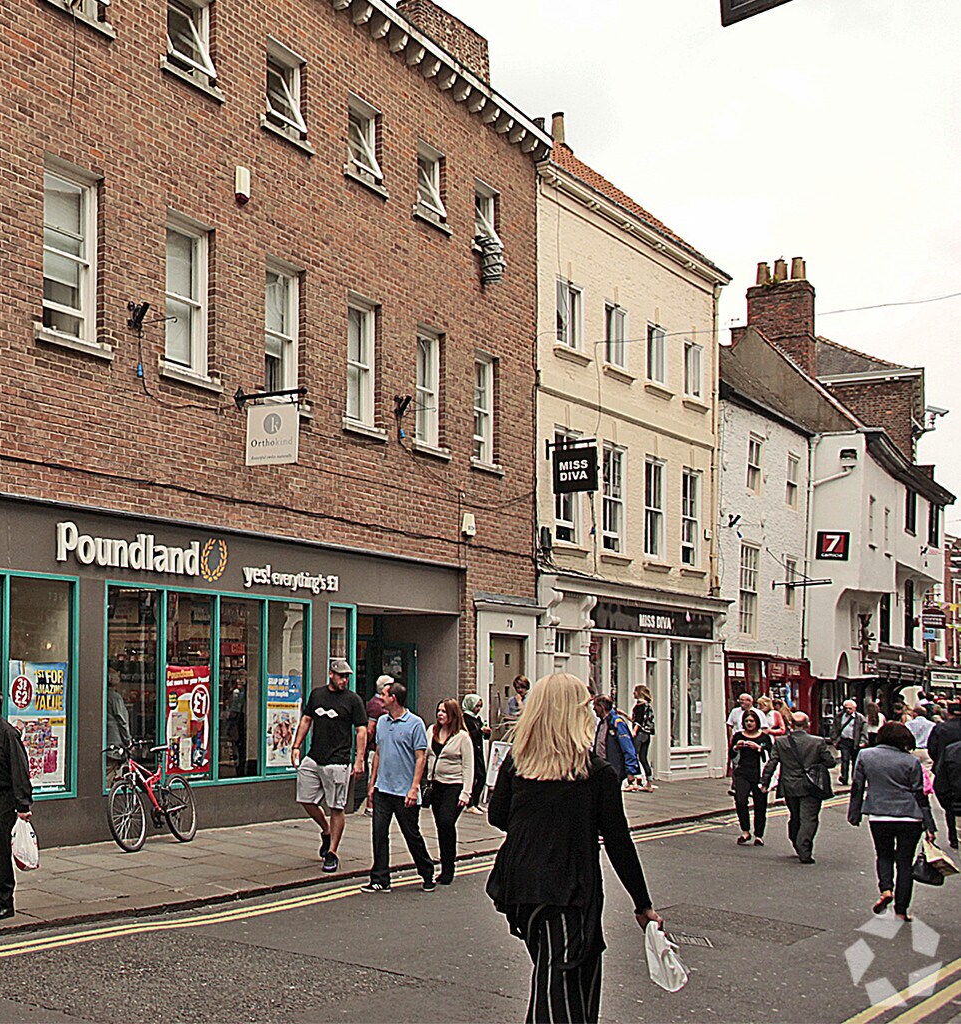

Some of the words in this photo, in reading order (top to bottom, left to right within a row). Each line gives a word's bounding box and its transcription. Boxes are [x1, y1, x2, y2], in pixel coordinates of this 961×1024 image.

[251, 437, 293, 448] Orthokind
[559, 459, 589, 471] MISS
[559, 470, 589, 481] DIVA
[56, 521, 200, 576] Poundland
[826, 535, 840, 552] 7
[242, 564, 271, 588] yes!
[271, 572, 327, 595] everything's
[639, 614, 656, 628] MISS
[656, 615, 672, 630] DIVA
[46, 670, 64, 684] FOR
[35, 695, 64, 711] VALUE
[193, 692, 207, 714] £1
